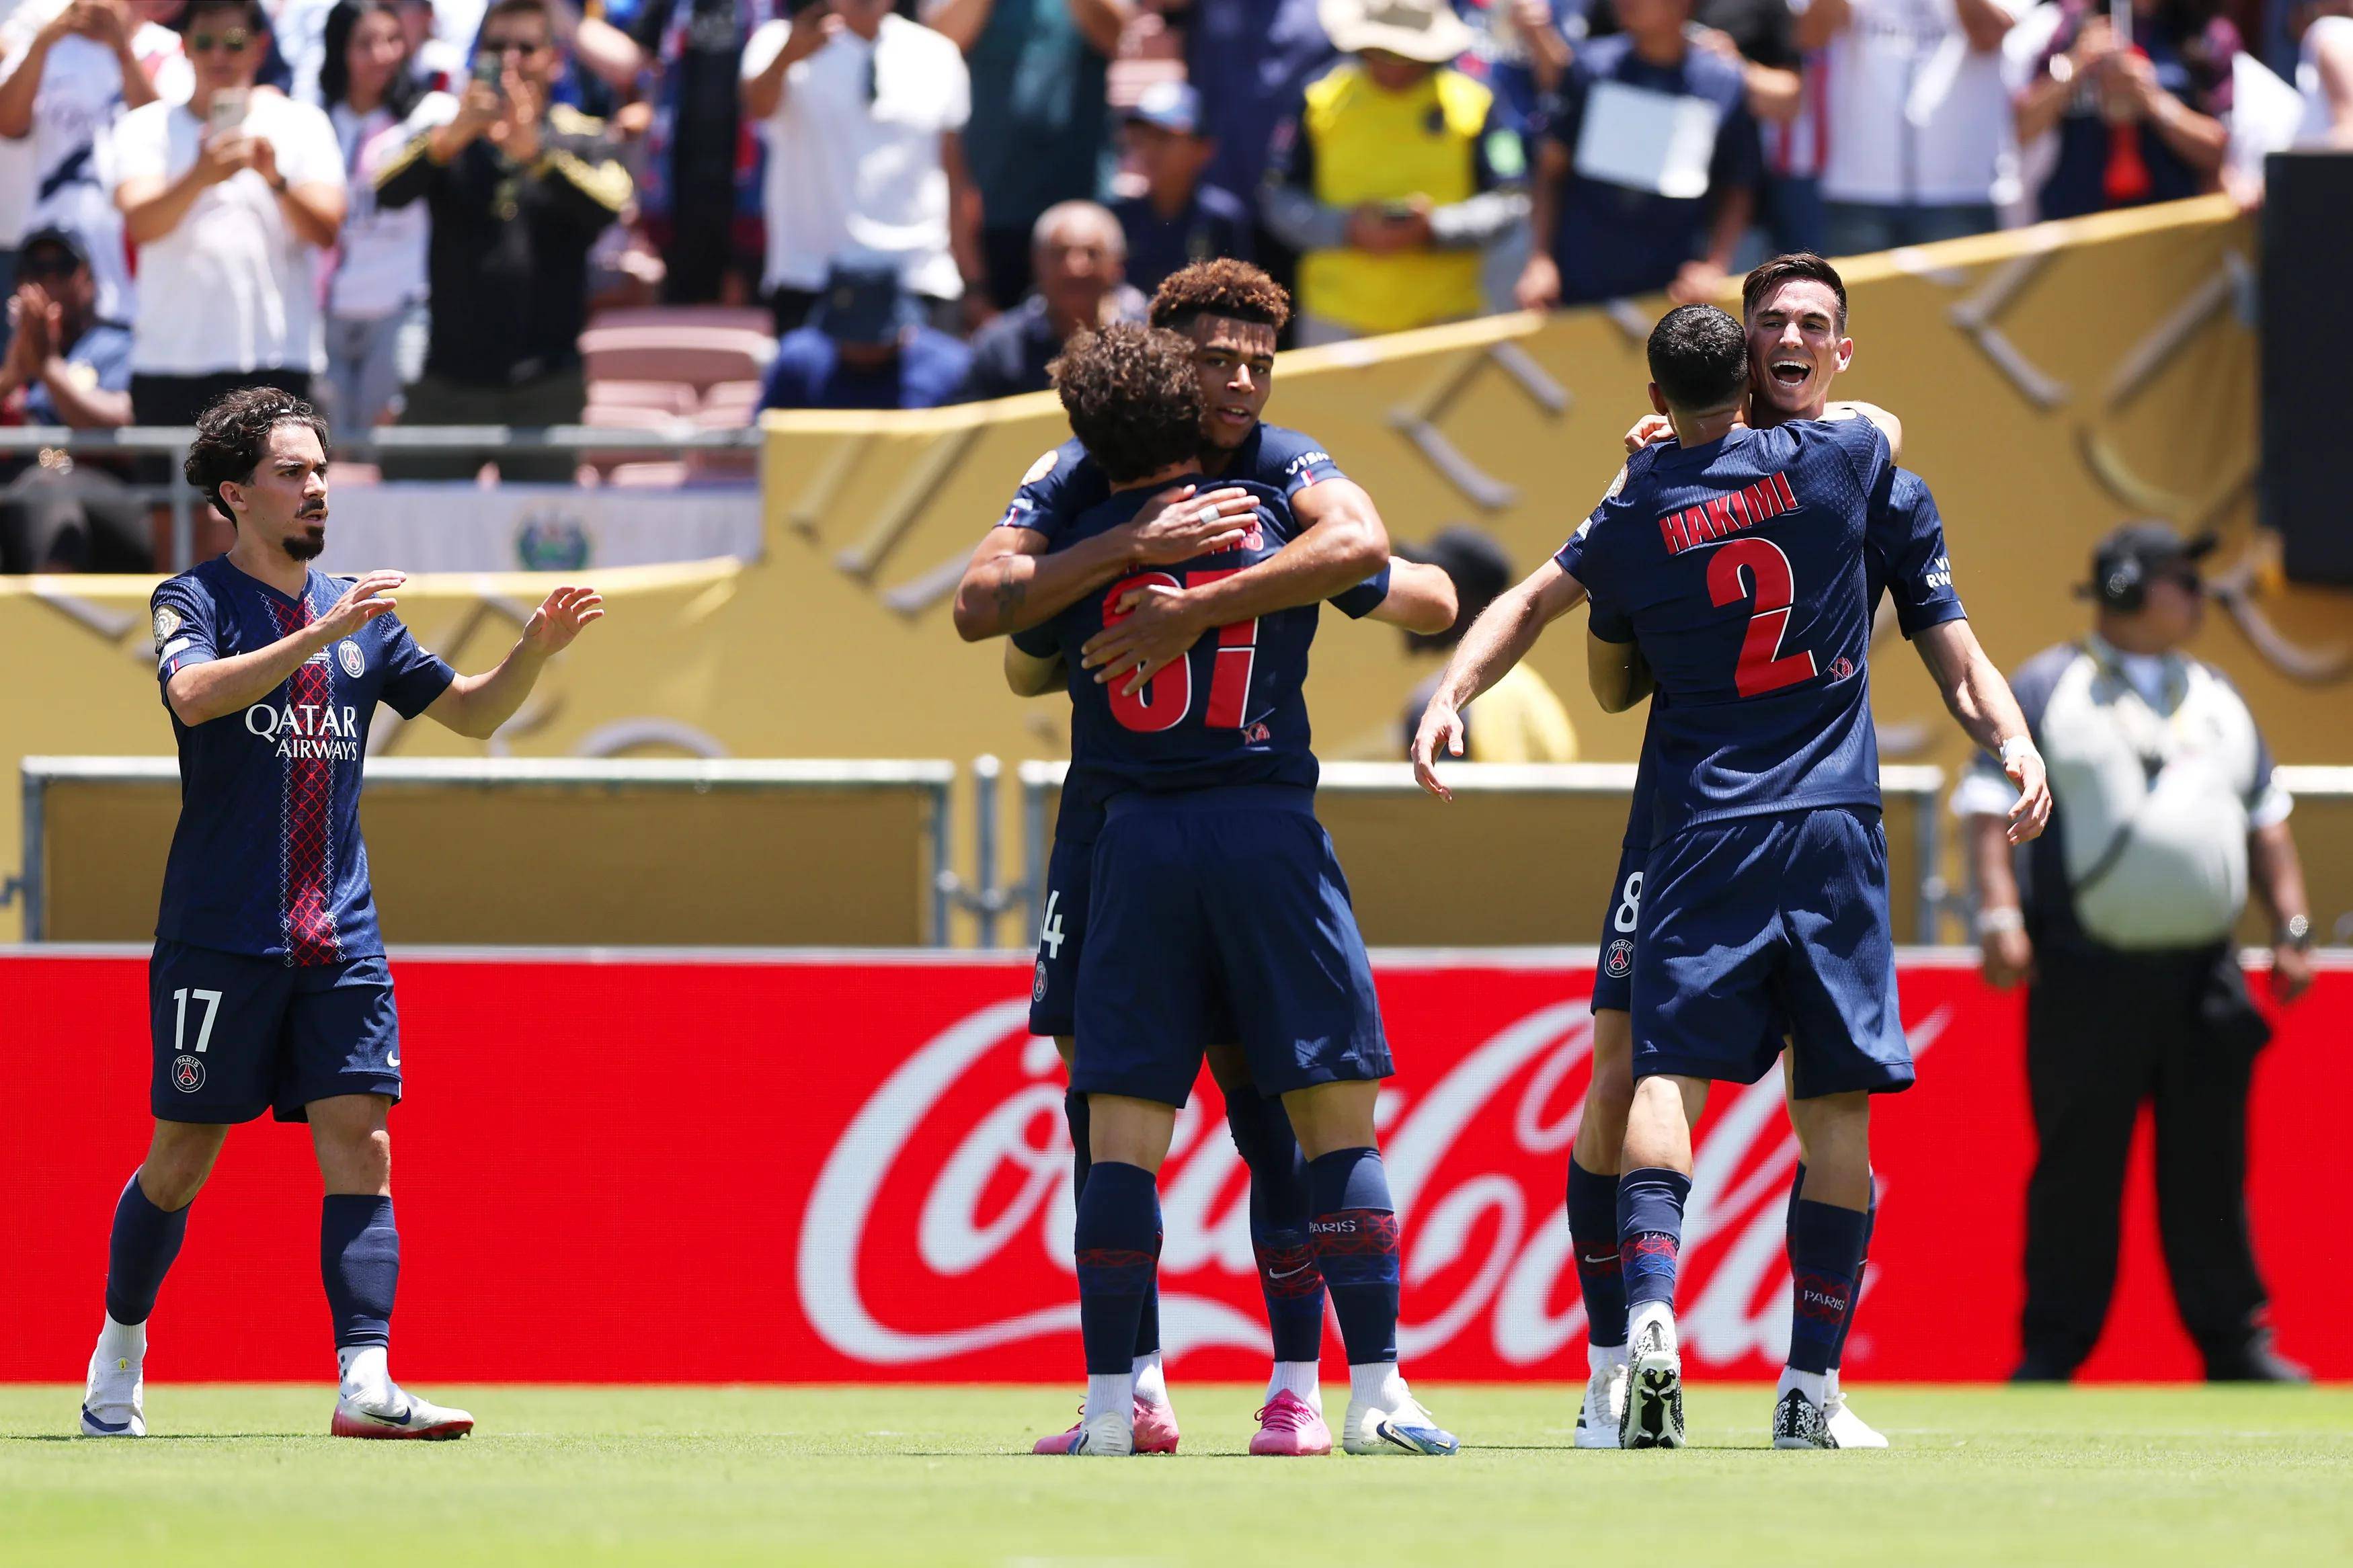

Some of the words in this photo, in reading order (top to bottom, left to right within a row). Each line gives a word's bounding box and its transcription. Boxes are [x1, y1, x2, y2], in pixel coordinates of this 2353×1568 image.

[1659, 470, 1798, 555] HAKIMI
[1706, 537, 1819, 698] 2
[245, 704, 358, 743] QATAR
[275, 739, 357, 761] AIRWAYS
[1614, 871, 1644, 933] 8
[1611, 941, 1634, 952] PARIS
[173, 987, 223, 1053] 17
[177, 1057, 200, 1068] PARIS
[1309, 1220, 1356, 1233] PARIS
[1804, 1290, 1845, 1311] PARIS
